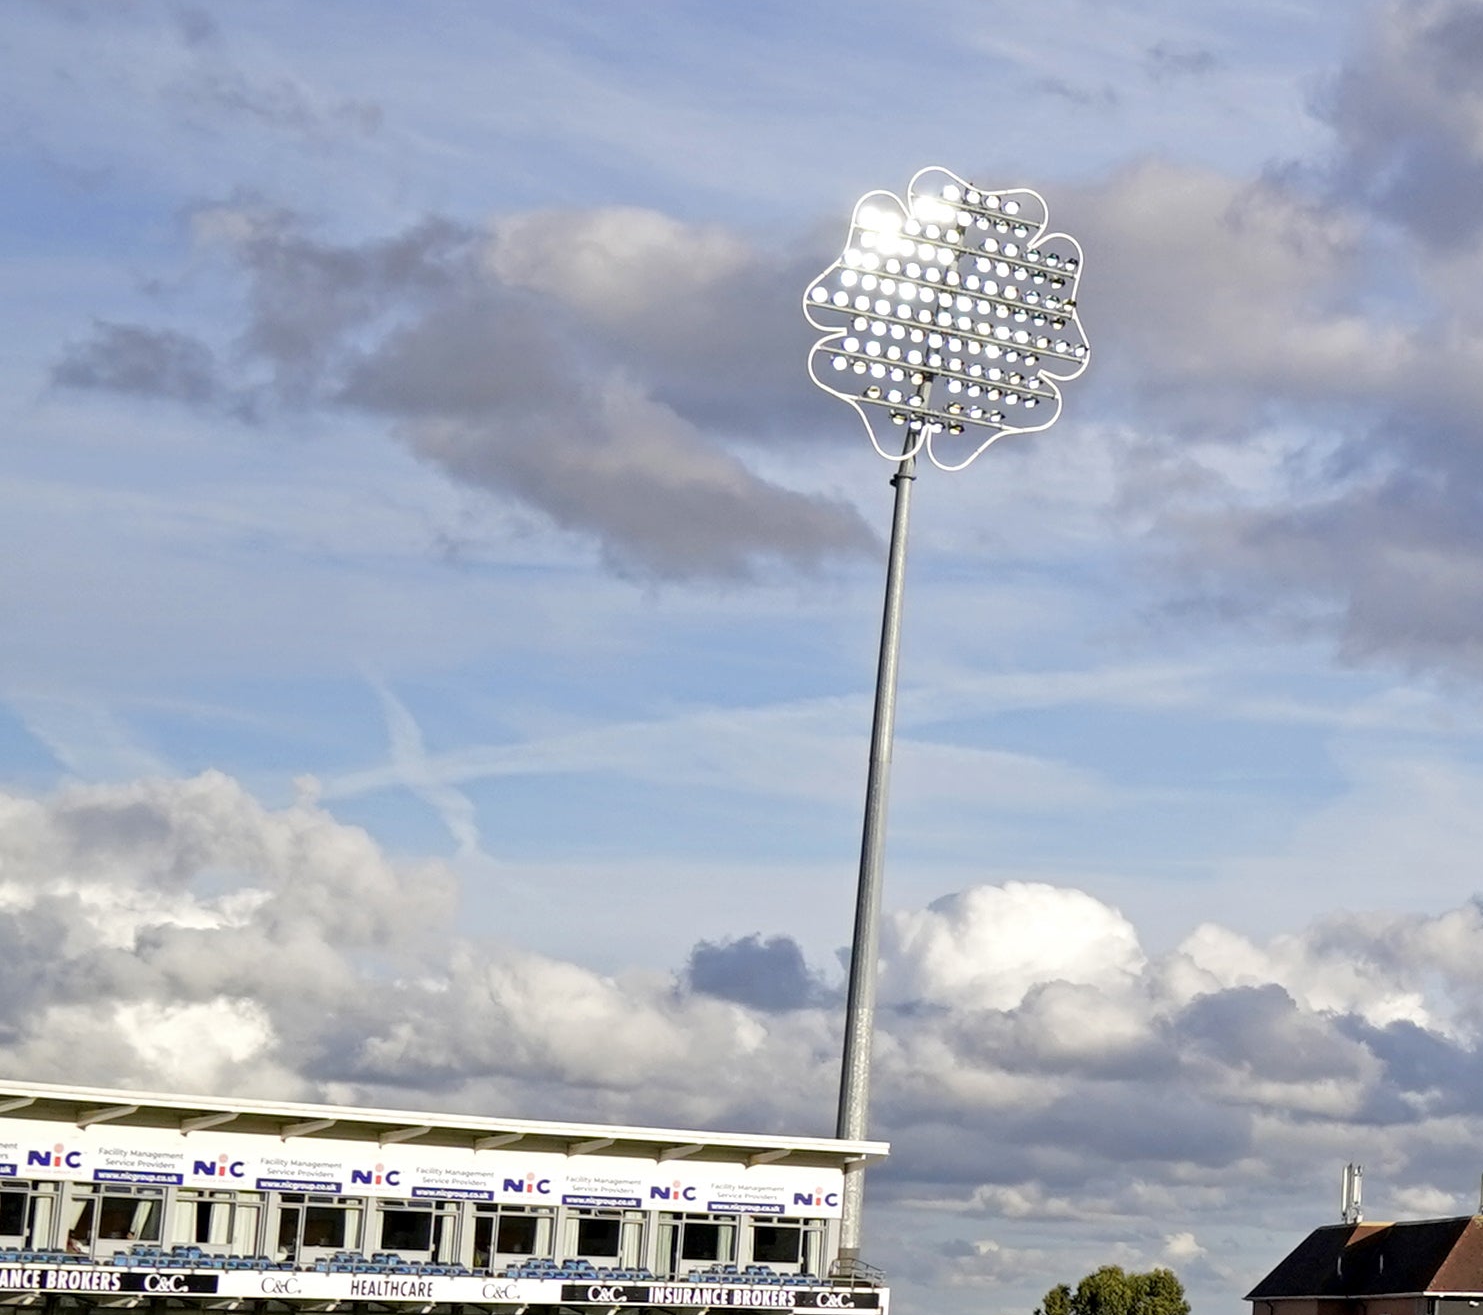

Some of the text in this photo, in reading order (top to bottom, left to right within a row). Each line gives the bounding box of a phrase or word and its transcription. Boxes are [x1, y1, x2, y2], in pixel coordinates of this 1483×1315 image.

[46, 1270, 121, 1291] BROKERS
[351, 1280, 433, 1297] HEALTHCARE
[649, 1287, 796, 1307] INSURANCE BROKERS
